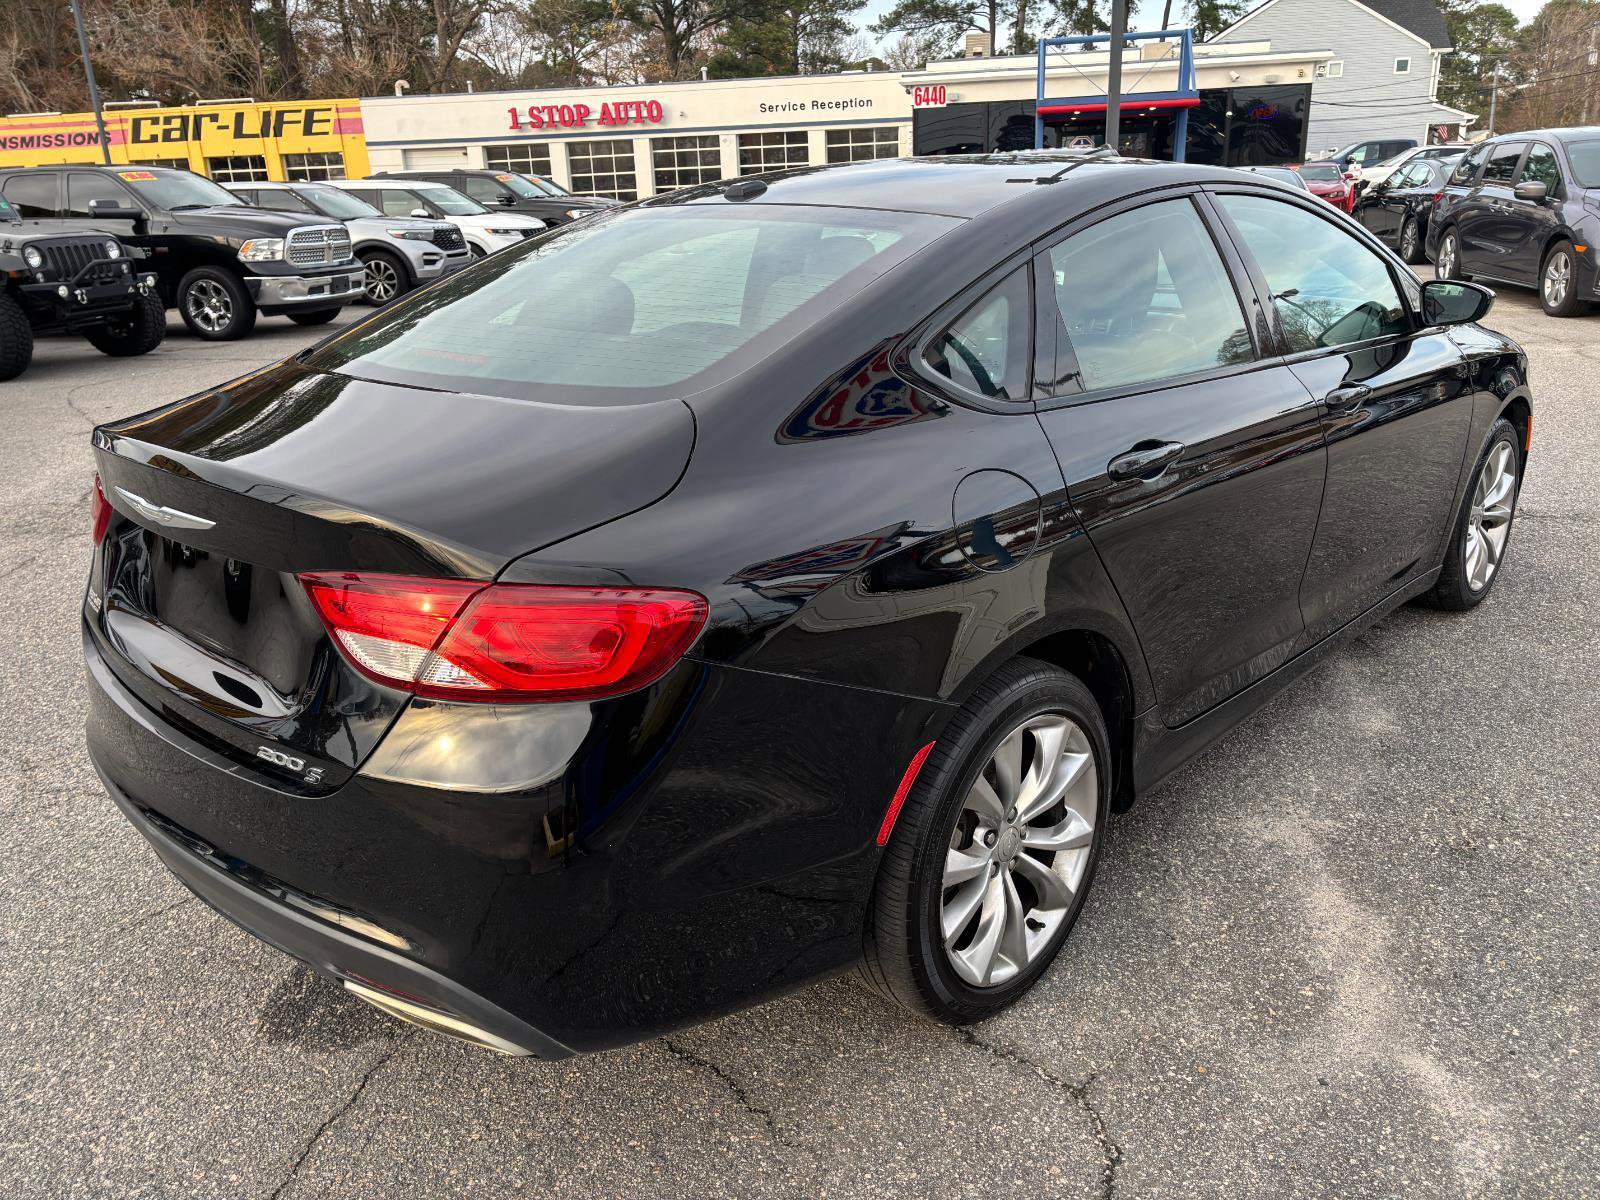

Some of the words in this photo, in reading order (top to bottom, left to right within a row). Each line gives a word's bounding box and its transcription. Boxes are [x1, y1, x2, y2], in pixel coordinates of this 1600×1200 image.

[759, 101, 806, 113] Service
[811, 97, 873, 111] Reception
[914, 85, 947, 107] 6440
[508, 107, 522, 130] 1
[528, 103, 590, 129] STOP
[597, 100, 663, 126] AUTO
